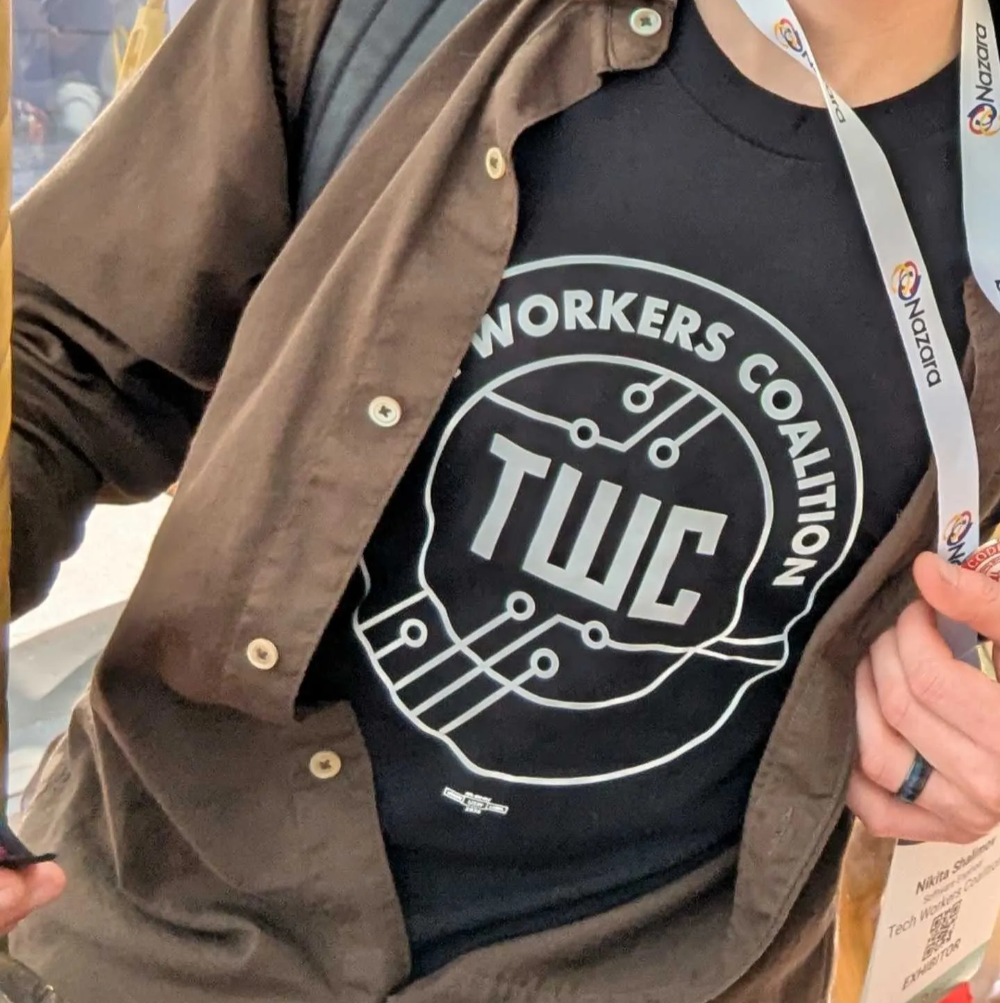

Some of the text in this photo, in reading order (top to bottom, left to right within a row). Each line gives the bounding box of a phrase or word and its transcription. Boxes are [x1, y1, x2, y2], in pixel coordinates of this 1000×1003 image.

[977, 22, 996, 103] Nazara
[904, 297, 942, 389] Nazara
[471, 289, 836, 588] WORKERS COALITION
[470, 433, 728, 627] TWC
[888, 915, 917, 939] Tech
[919, 887, 962, 922] Workers
[915, 869, 950, 895] Nikita
[901, 938, 961, 991] EXHIBITOR
